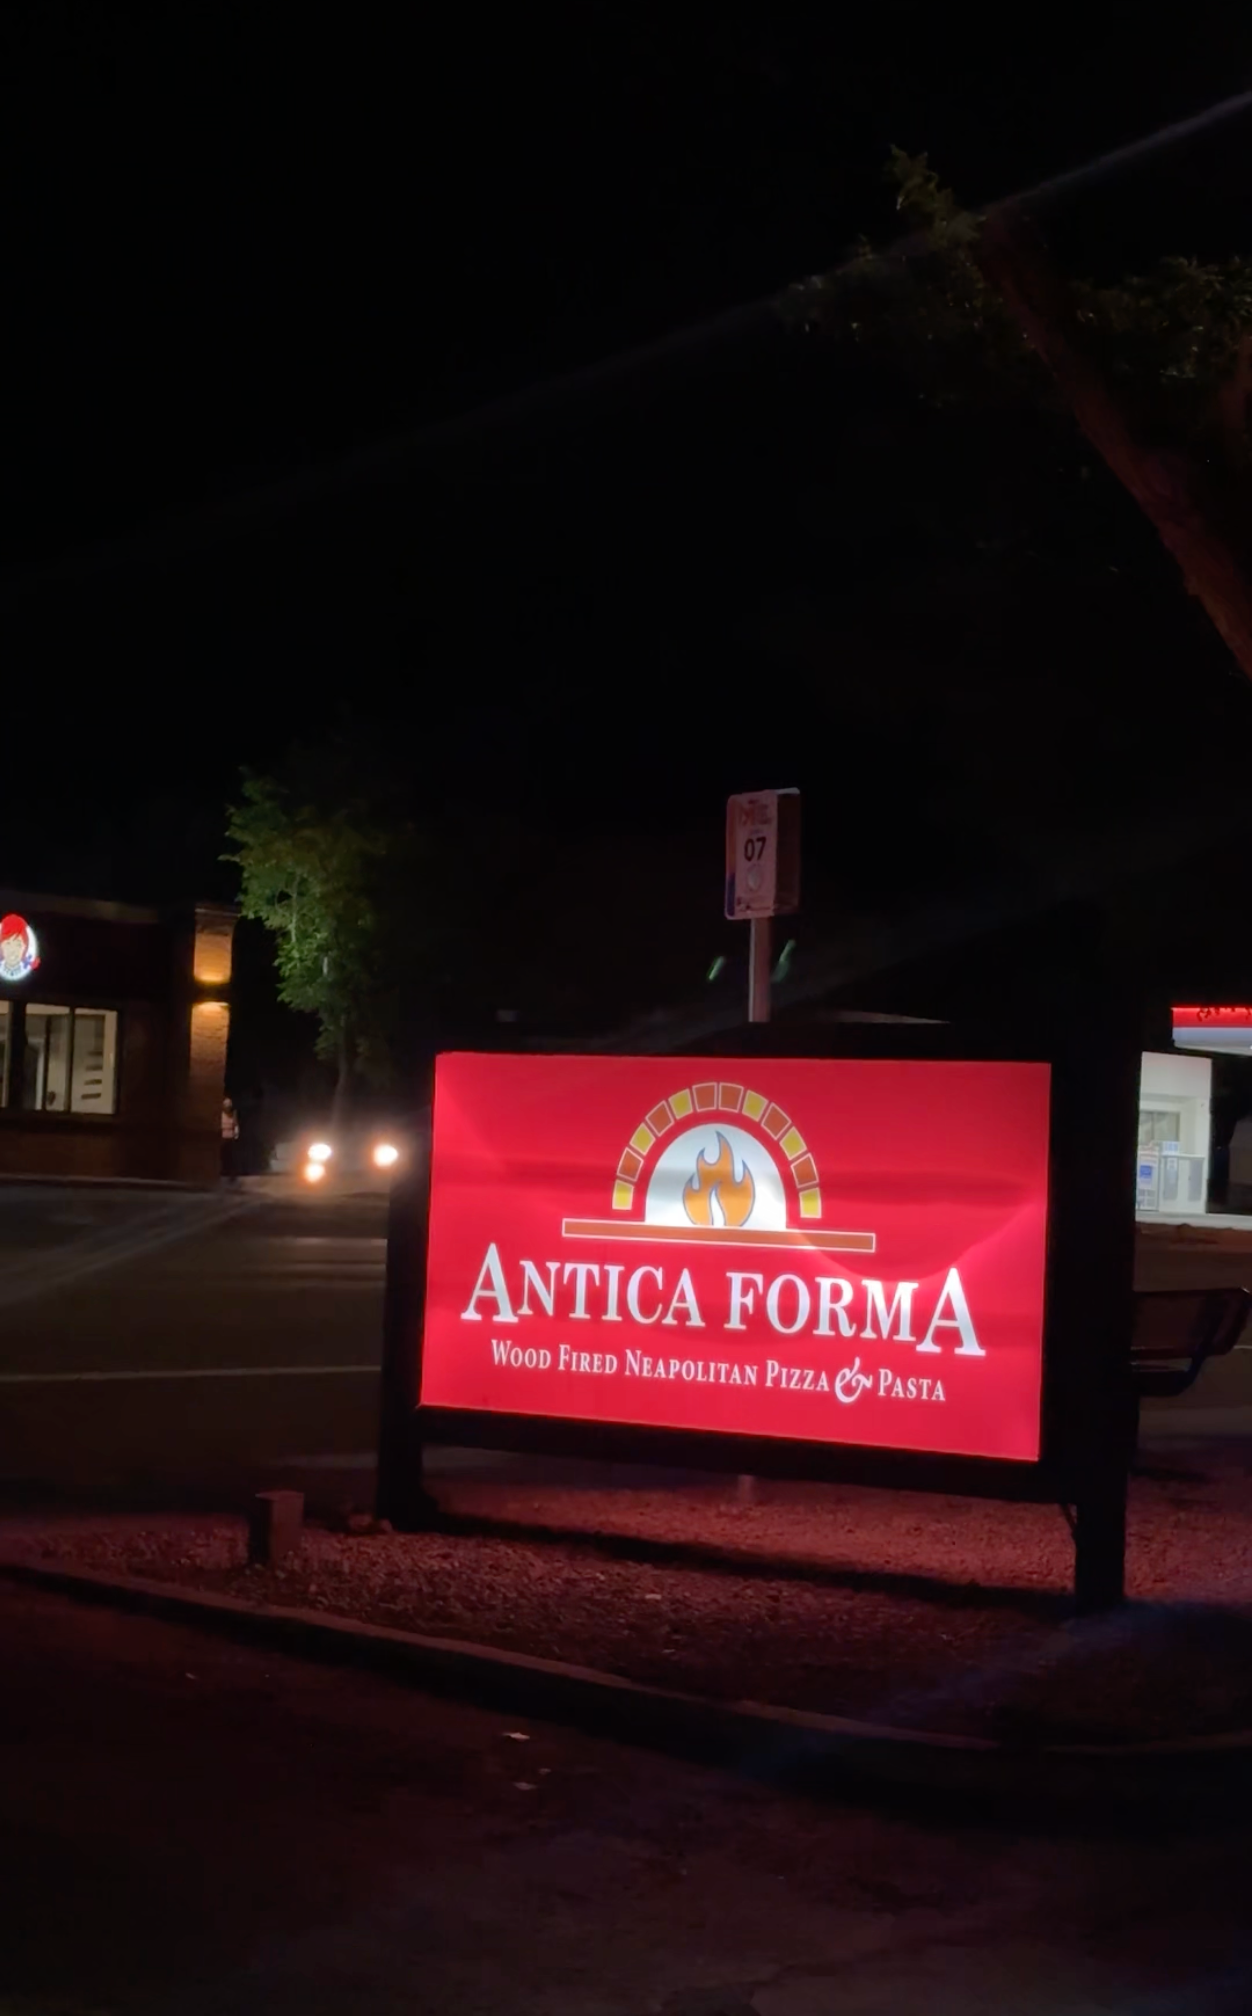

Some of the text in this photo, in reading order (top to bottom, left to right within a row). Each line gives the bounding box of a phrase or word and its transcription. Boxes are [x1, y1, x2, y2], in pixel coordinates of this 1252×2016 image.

[744, 836, 766, 861] 07
[460, 1242, 986, 1356] ANTICA FORMA
[835, 1357, 872, 1403] &
